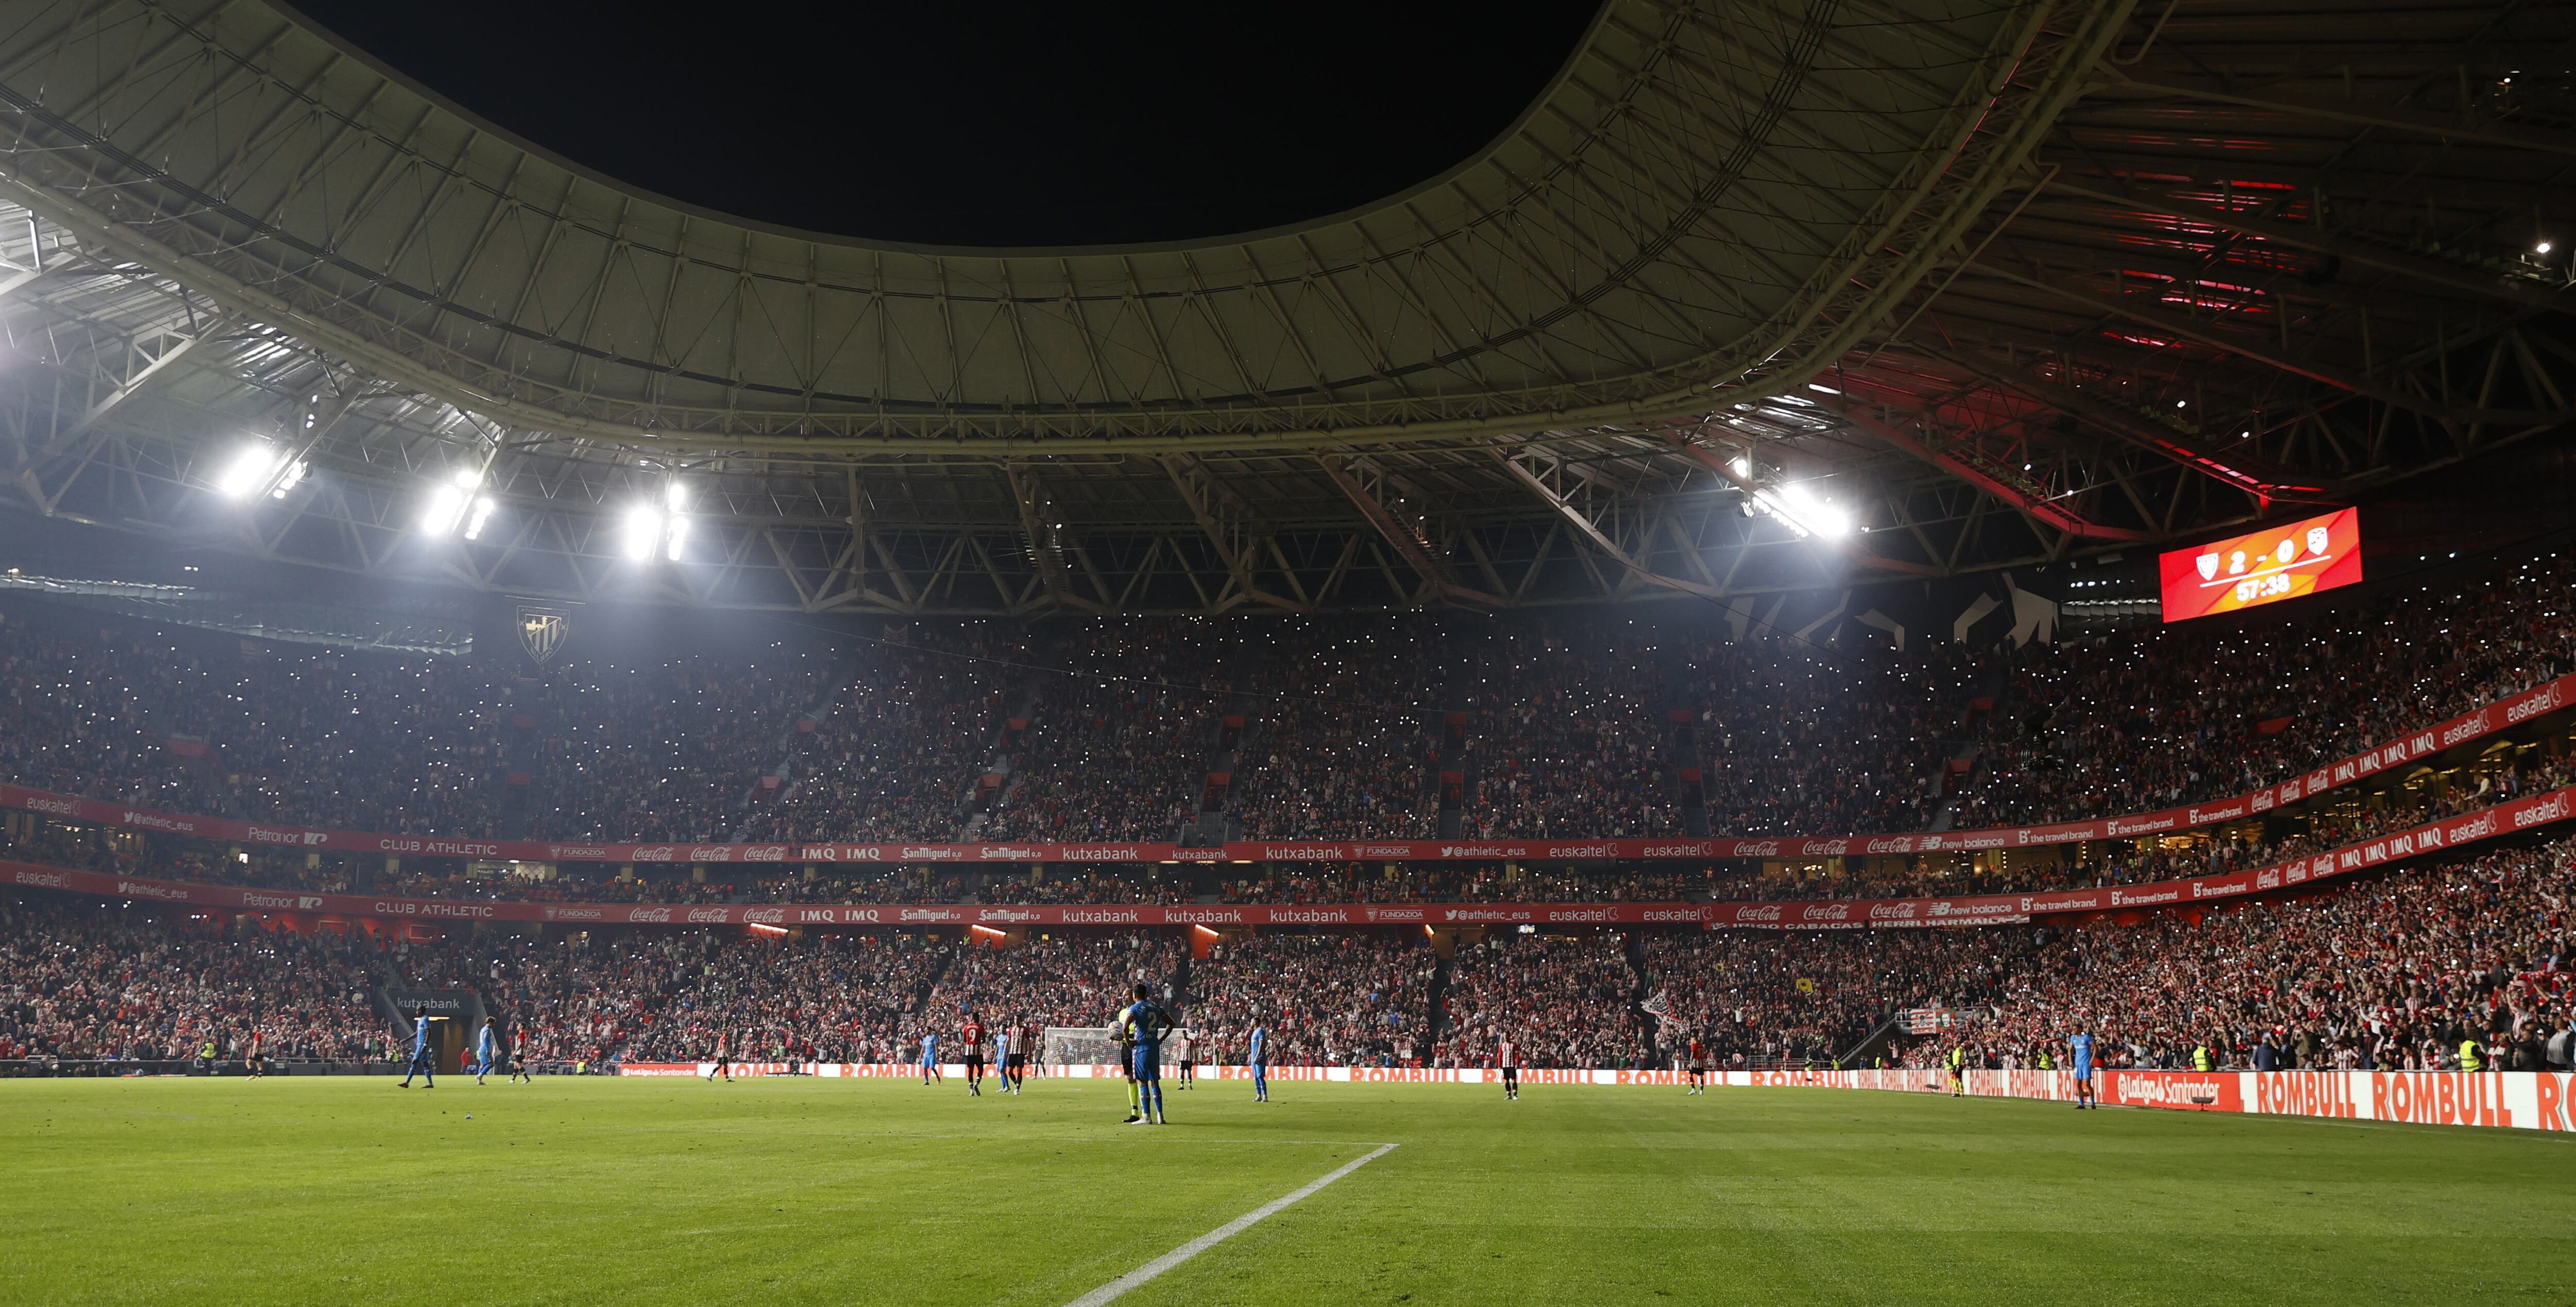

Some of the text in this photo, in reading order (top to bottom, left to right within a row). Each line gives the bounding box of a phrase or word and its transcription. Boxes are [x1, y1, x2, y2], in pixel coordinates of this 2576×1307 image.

[2229, 551, 2245, 574] 2
[2277, 539, 2294, 563] 0
[2236, 573, 2290, 601] 57:38
[2507, 689, 2551, 722] euskaltel
[2444, 715, 2481, 745] euskaltel
[2412, 732, 2435, 754] IMQ
[2384, 743, 2407, 764] IMQ
[2360, 752, 2380, 772] IMQ
[2335, 762, 2355, 782] IMQ
[27, 797, 72, 814] euskaltel
[2515, 799, 2560, 827] euskaltel
[2198, 813, 2207, 822] the
[2209, 810, 2226, 821] travel
[2226, 806, 2242, 817] brand
[133, 813, 193, 831] @athletic_eus
[2119, 825, 2130, 834] the
[2132, 821, 2153, 833] travel
[2154, 818, 2173, 830] brand
[2450, 816, 2488, 843] euskaltel
[1943, 840, 1962, 849] new
[1964, 837, 2004, 847] balance
[2031, 834, 2043, 842] the
[2045, 831, 2069, 842] travel
[2071, 829, 2093, 840] brand
[2418, 827, 2442, 848] IMQ
[380, 839, 497, 855] CLUB ATHLETIC
[1454, 845, 1526, 856] @athletic_eus
[1550, 845, 1605, 857] euskaltel
[1644, 844, 1700, 856] euskaltel
[2365, 840, 2386, 862] IMQ
[2391, 834, 2414, 855] IMQ
[802, 848, 835, 861] IMQ
[846, 848, 880, 861] IMQ
[1063, 847, 1138, 860] kutxabank
[1173, 850, 1227, 860] kutxabank
[1266, 846, 1343, 859] kutxabank
[2341, 847, 2362, 868] IMQ
[16, 872, 61, 887] euskaltel
[128, 883, 188, 899] @athletic_eus
[2202, 887, 2212, 895] the
[2213, 884, 2229, 895] travel
[2230, 881, 2246, 892] brand
[243, 893, 293, 908] Petronor
[2033, 902, 2046, 911] the
[2048, 899, 2071, 910] travel
[2072, 897, 2096, 909] brand
[2122, 896, 2134, 904] the
[2136, 893, 2157, 904] travel
[2158, 890, 2177, 901] brand
[376, 902, 493, 917] CLUB ATHLETIC
[1063, 909, 1139, 922] kutxabank
[1165, 909, 1241, 922] kutxabank
[1270, 909, 1347, 922] kutxabank
[1458, 910, 1530, 920] @athletic_eus
[1550, 909, 1605, 921] euskaltel
[1644, 909, 1700, 921] euskaltel
[1972, 903, 2011, 913] balance
[801, 910, 834, 922] IMQ
[845, 910, 878, 922] IMQ
[398, 997, 460, 1009] kutxabank
[1147, 1012, 1157, 1031] 2
[969, 1029, 976, 1042] 9
[631, 1068, 696, 1077] LaLiga Santander
[1350, 1067, 1463, 1082] ROMBULL
[2010, 1070, 2050, 1099] ROMBULL
[2126, 1073, 2155, 1105] LaLiga
[2257, 1072, 2355, 1118] ROMBULL
[2373, 1072, 2511, 1127] ROMBULL
